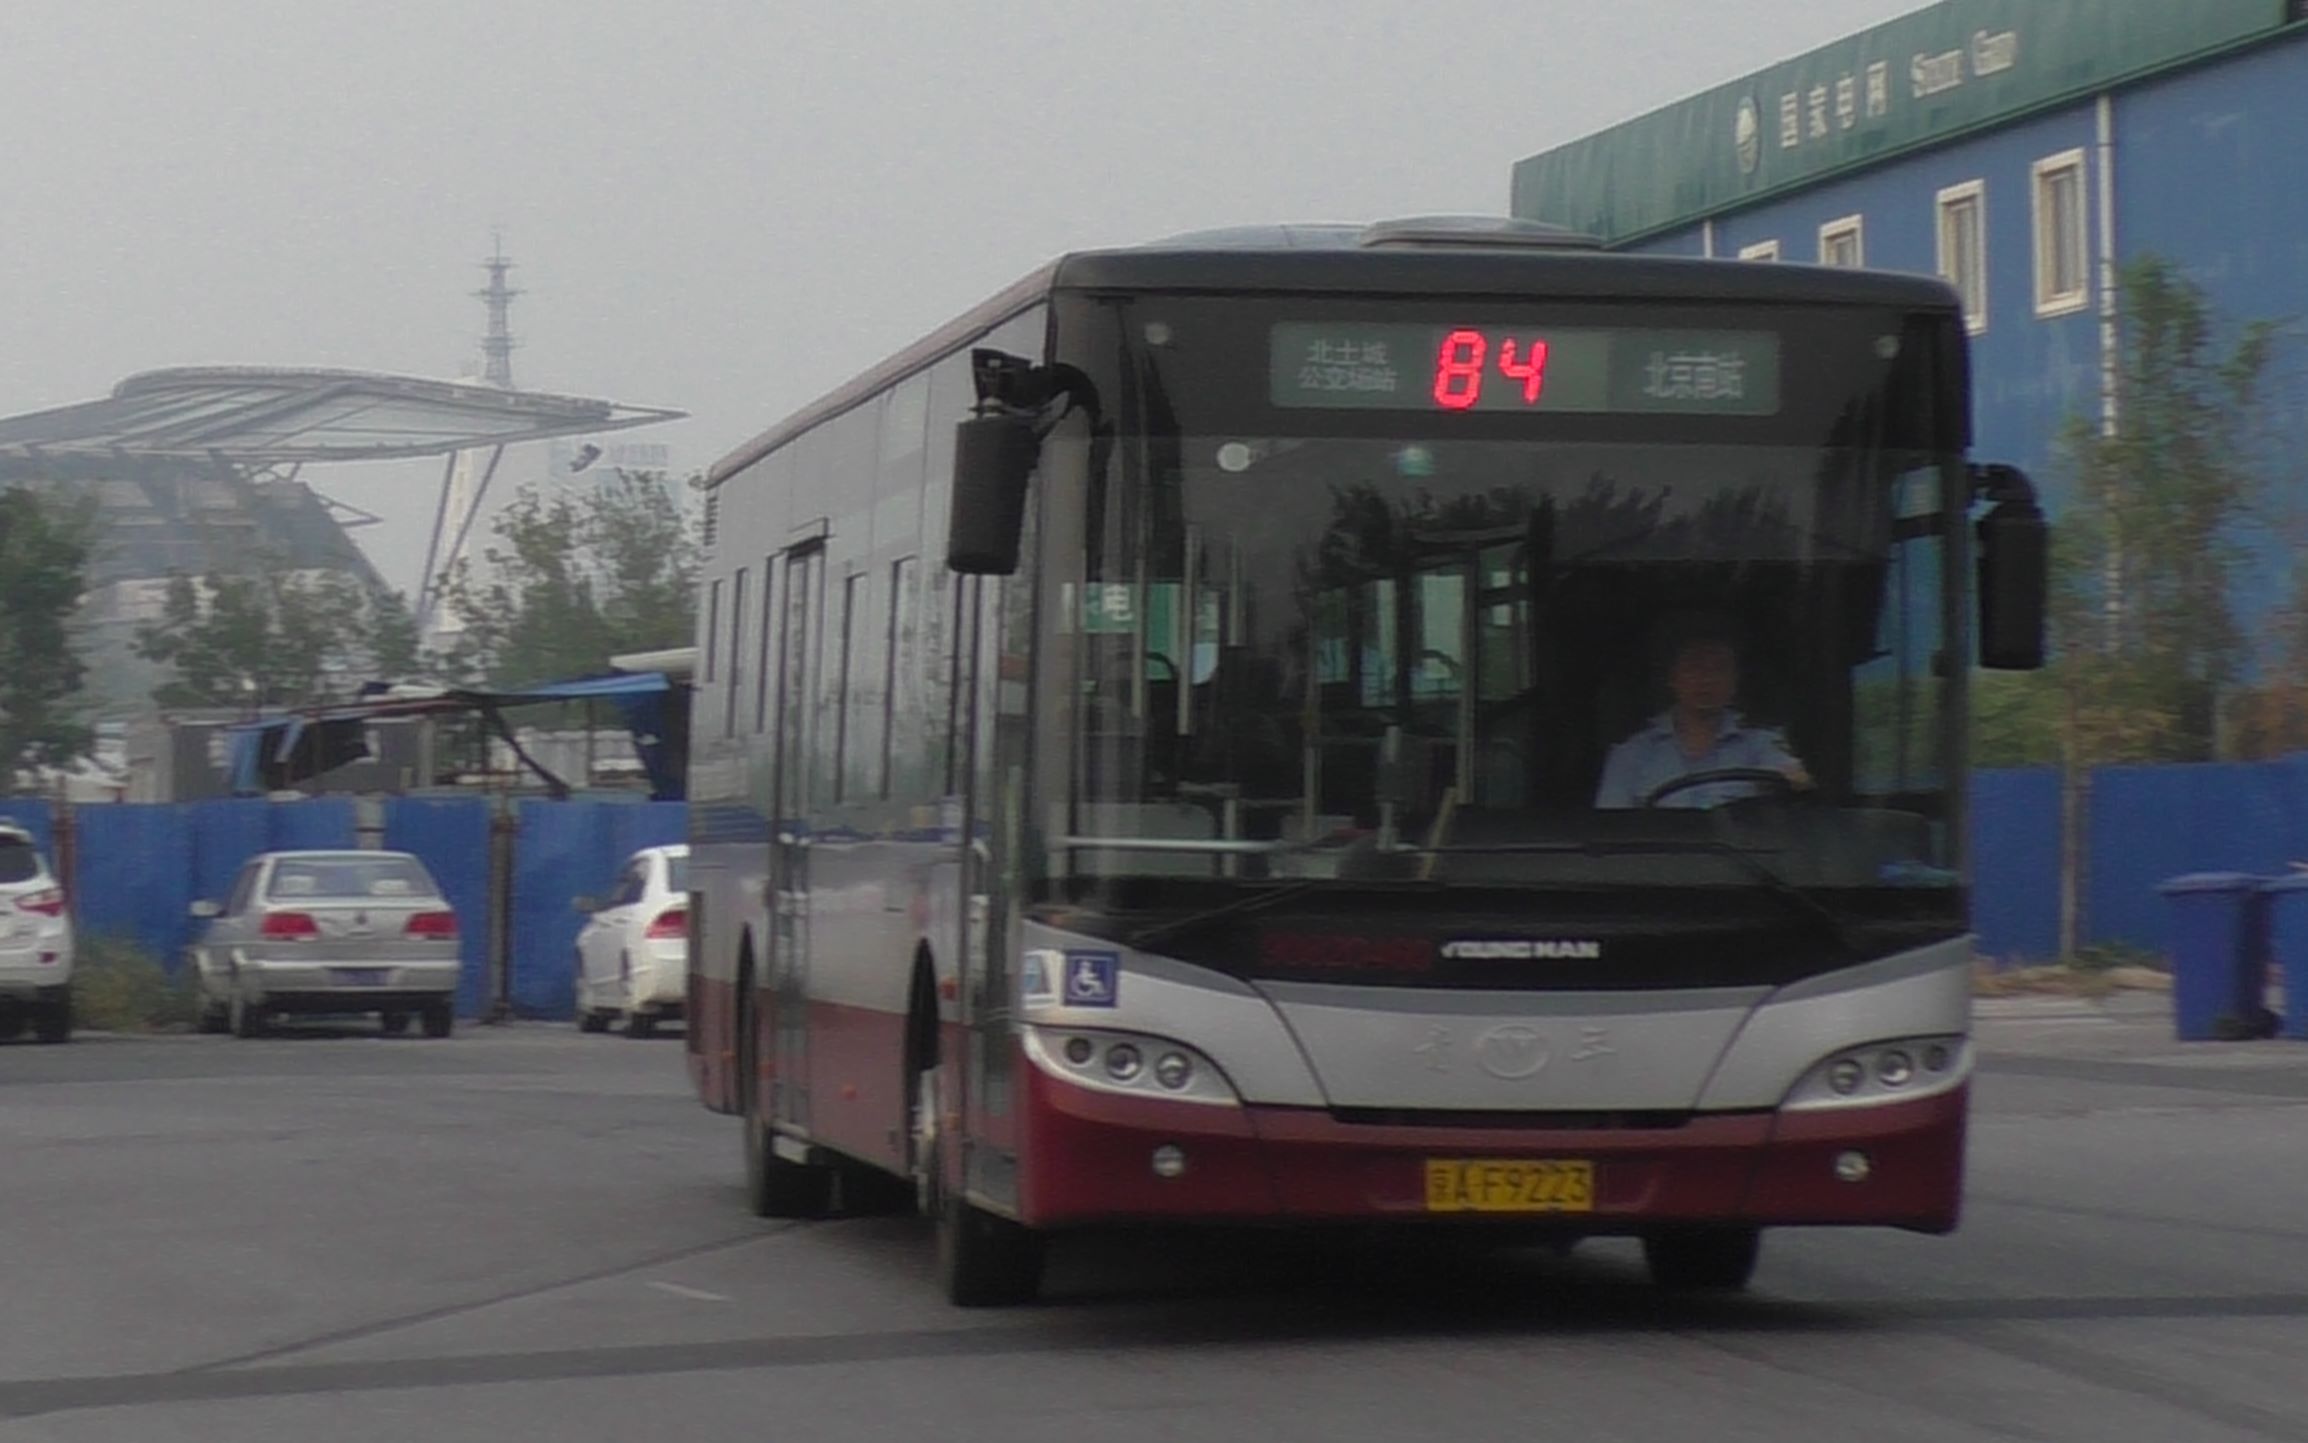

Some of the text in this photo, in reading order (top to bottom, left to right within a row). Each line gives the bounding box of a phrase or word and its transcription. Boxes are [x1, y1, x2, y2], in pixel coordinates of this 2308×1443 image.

[1305, 338, 1389, 365] 北土城
[1433, 328, 1549, 408] 84
[1641, 350, 1746, 399] 北京南站
